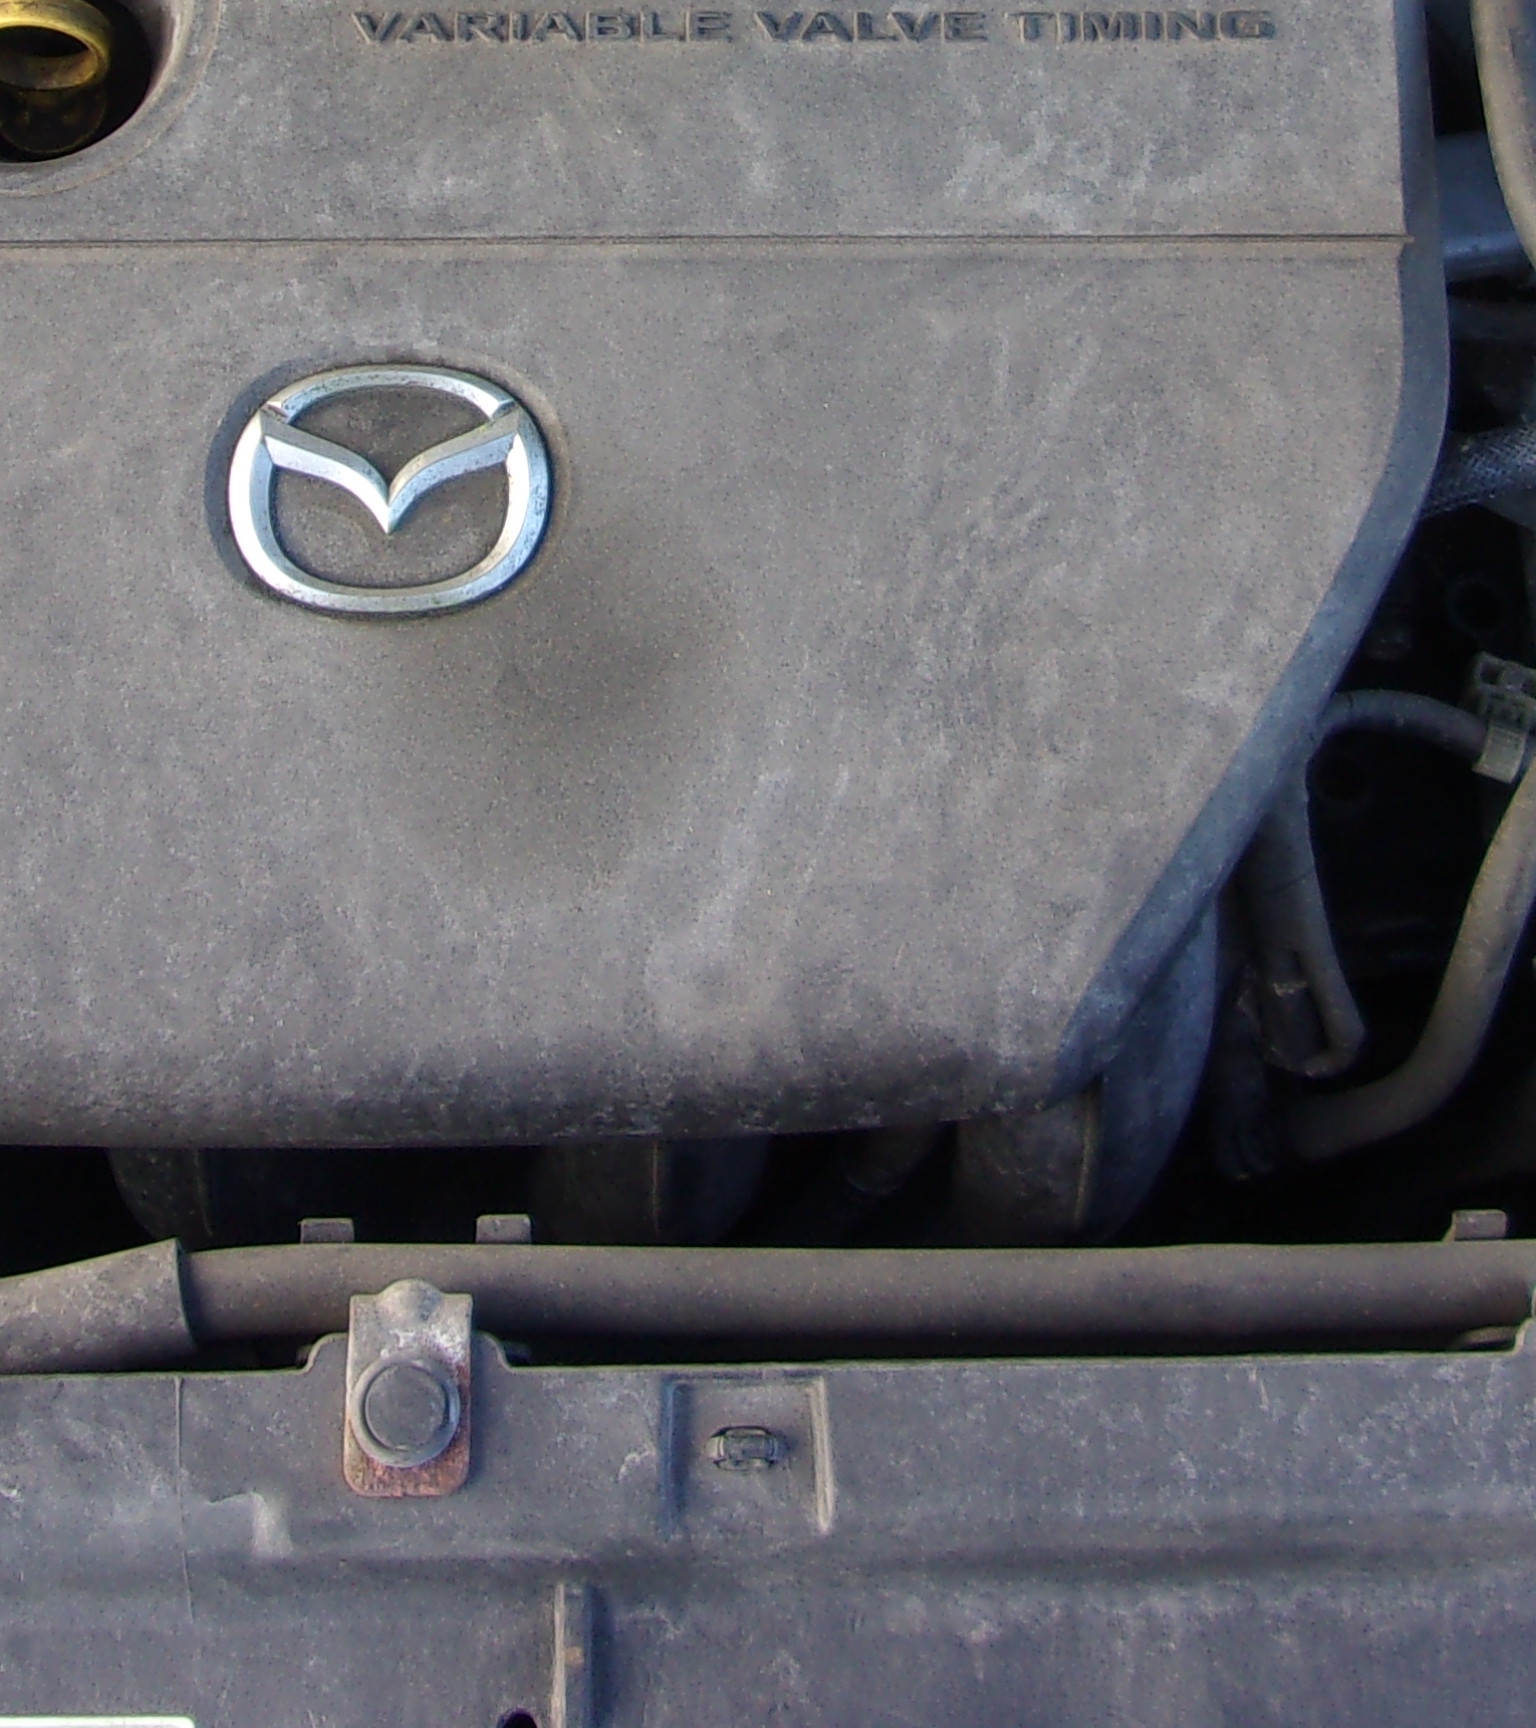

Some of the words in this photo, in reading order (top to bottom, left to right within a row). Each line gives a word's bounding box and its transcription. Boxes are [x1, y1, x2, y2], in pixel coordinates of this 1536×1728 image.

[350, 10, 734, 44] VARIABLE
[753, 10, 988, 43] VALVE
[1005, 10, 1278, 43] TIMING
